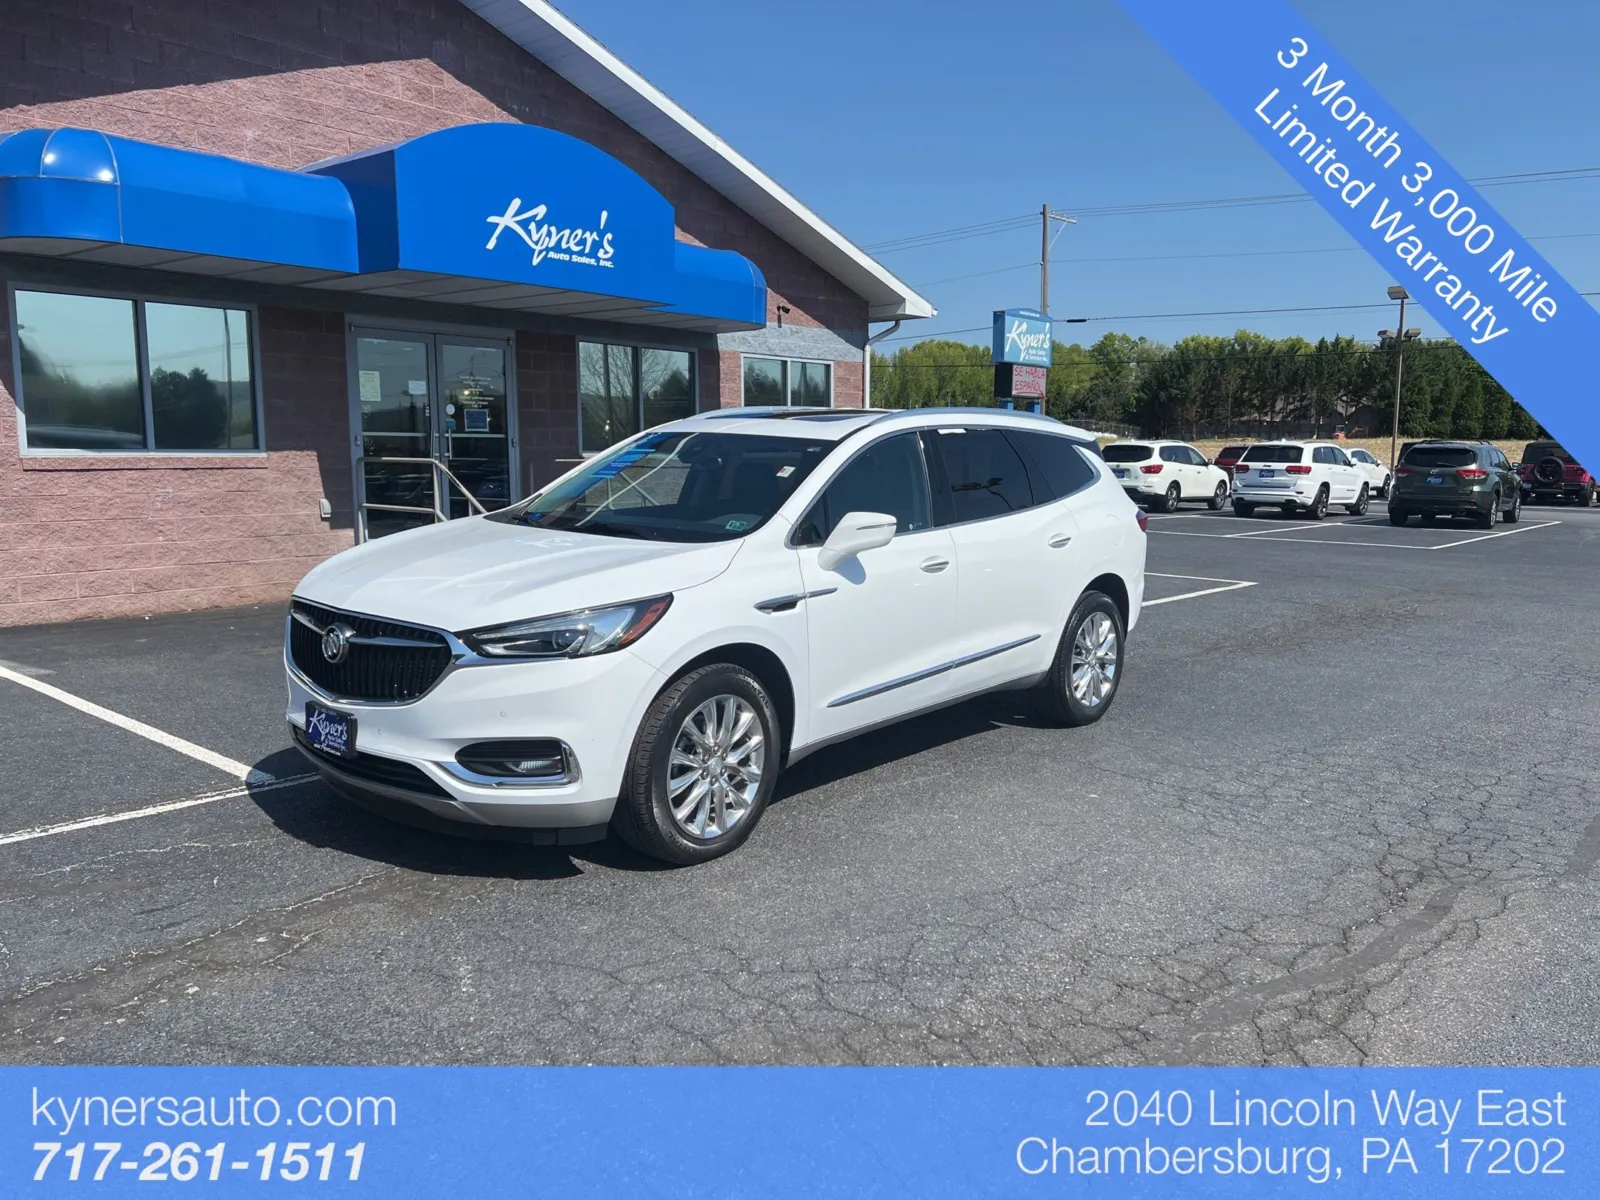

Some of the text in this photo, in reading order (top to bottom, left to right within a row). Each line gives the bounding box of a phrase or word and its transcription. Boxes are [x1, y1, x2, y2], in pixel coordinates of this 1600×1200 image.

[486, 197, 614, 266] Kyner's
[547, 251, 615, 268] Auto Sales, Inc.
[1005, 320, 1050, 361] Kyner's
